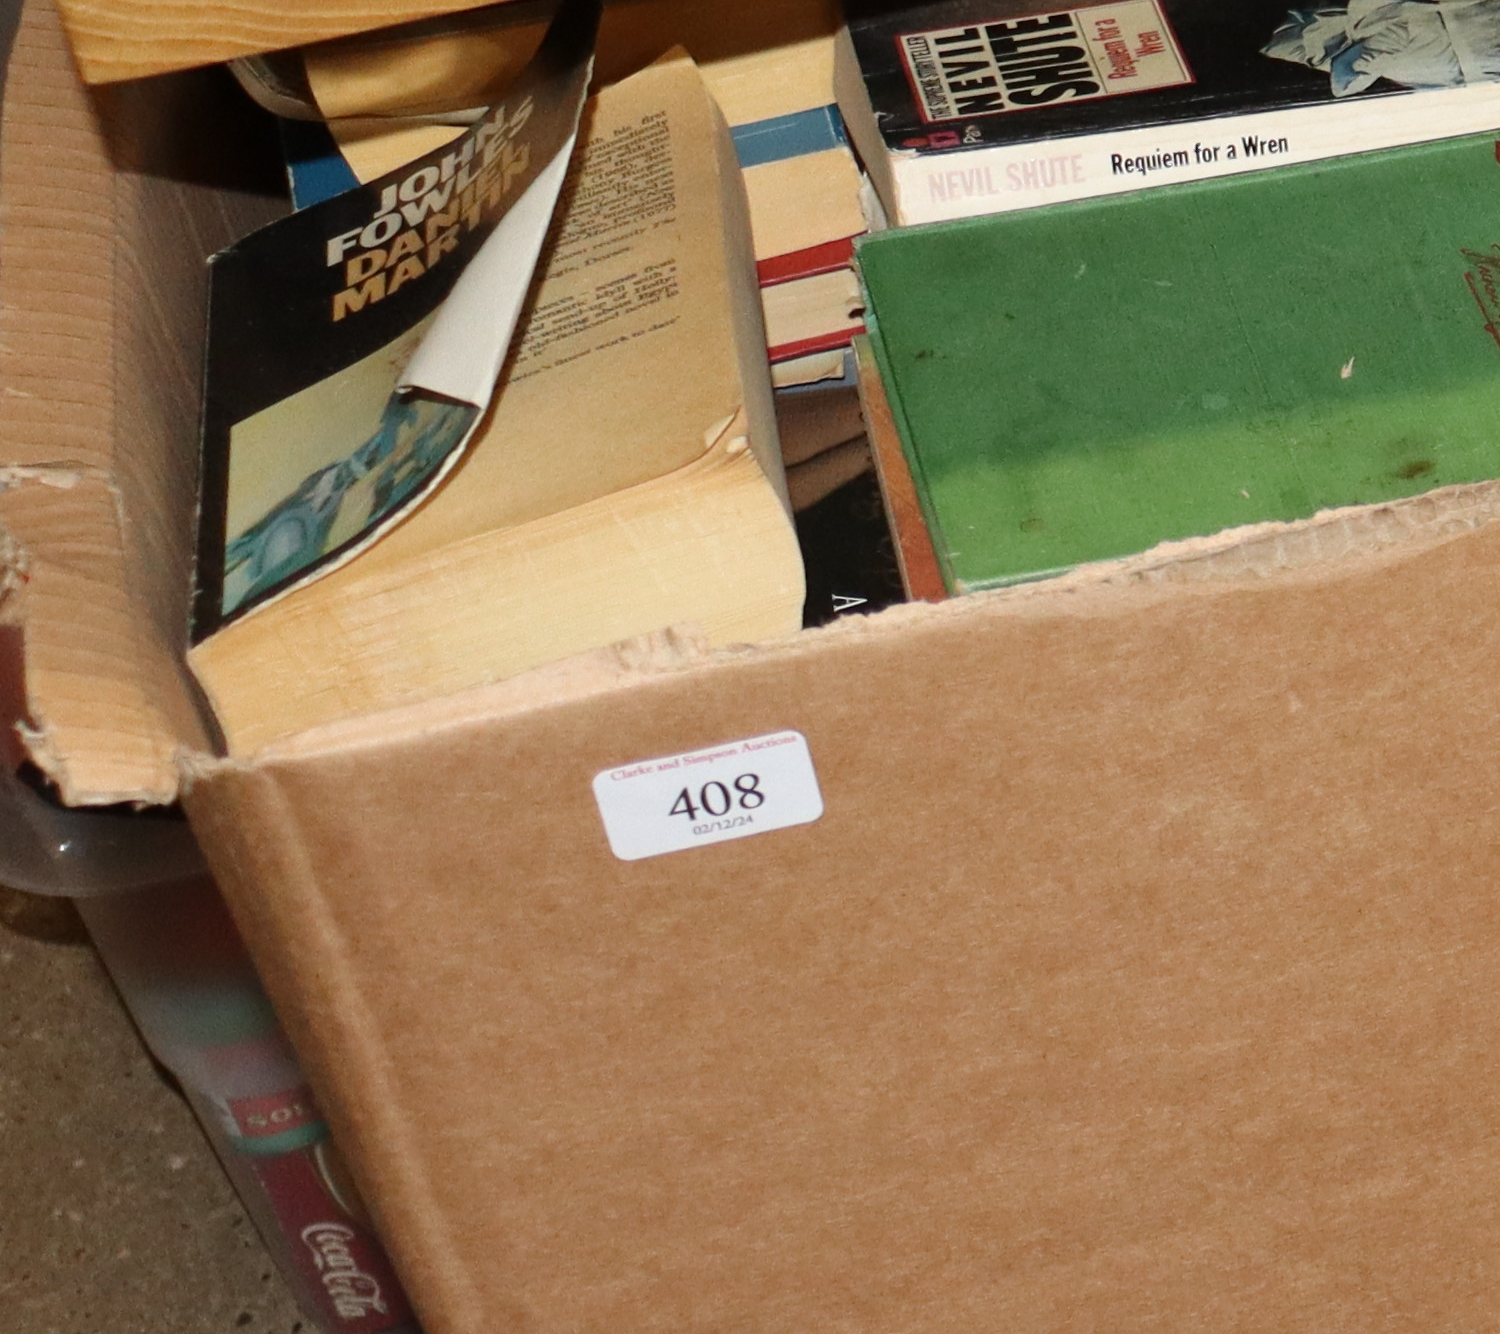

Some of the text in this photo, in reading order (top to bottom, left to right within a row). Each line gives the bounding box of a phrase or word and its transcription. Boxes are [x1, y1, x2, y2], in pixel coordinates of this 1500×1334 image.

[984, 13, 1101, 105] SHUTE
[1103, 40, 1137, 80] Requiem
[1134, 30, 1167, 57] Wren
[934, 27, 1006, 115] NEVIL
[327, 95, 534, 267] FOWLES
[373, 105, 506, 219] JOHN
[928, 134, 1290, 205] NEVIL SHUTE Requiem for a Wren
[831, 593, 868, 612] A
[610, 733, 798, 783] Clarke and Simpson Auctions
[668, 772, 766, 822] 408
[692, 814, 754, 836] 02/12/24
